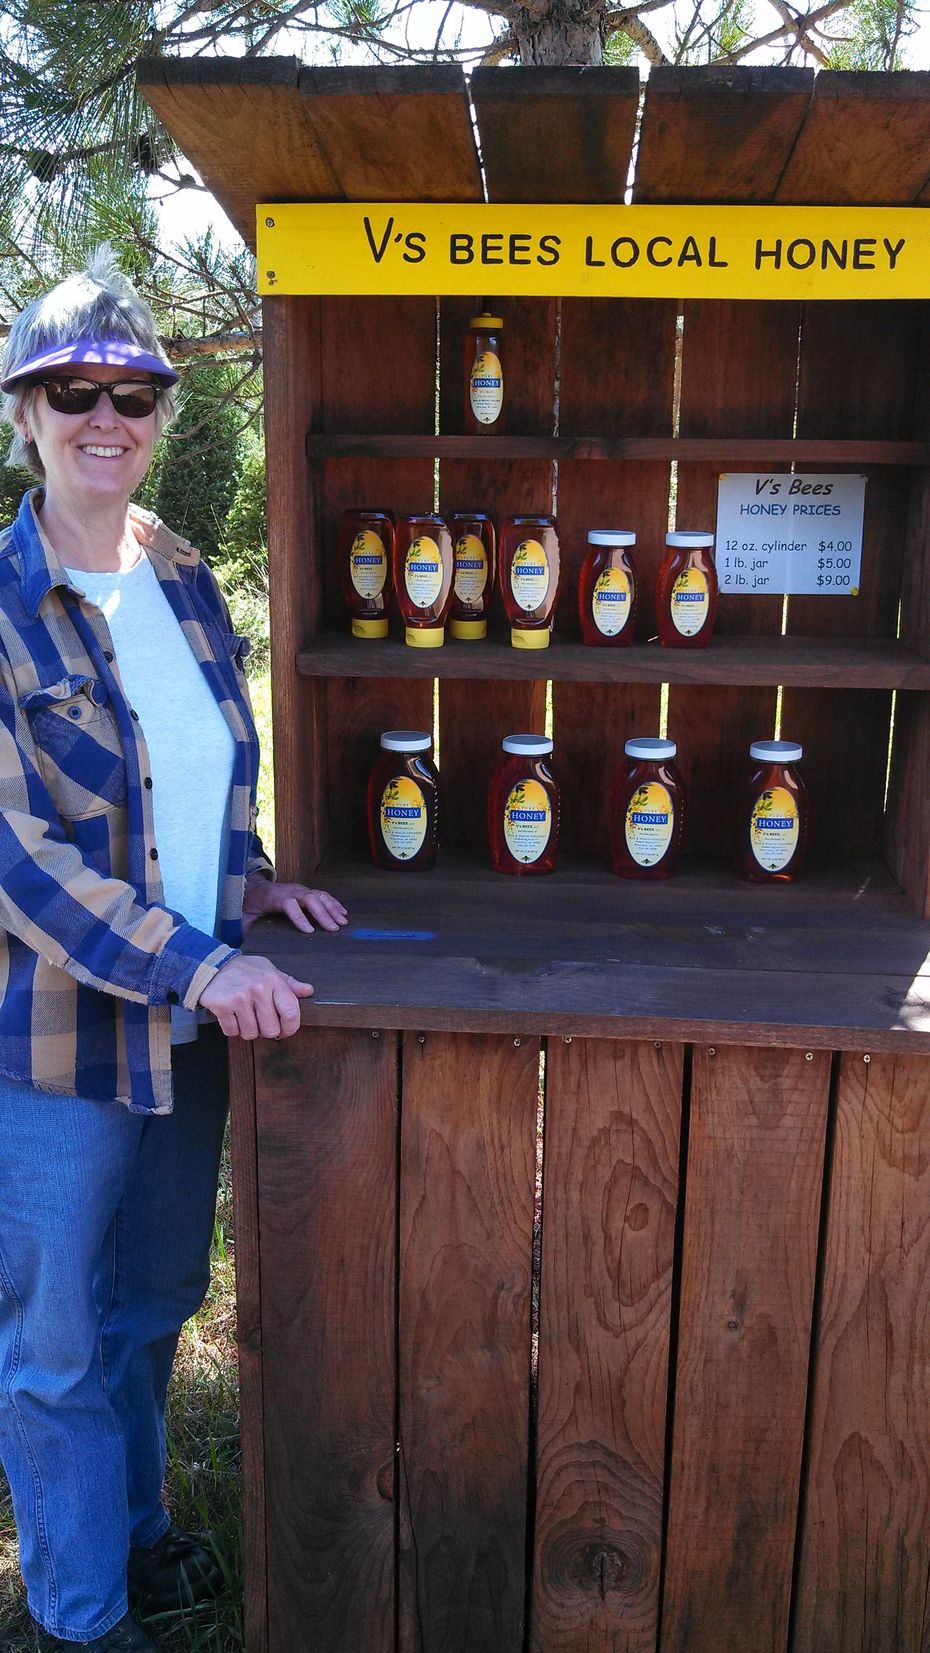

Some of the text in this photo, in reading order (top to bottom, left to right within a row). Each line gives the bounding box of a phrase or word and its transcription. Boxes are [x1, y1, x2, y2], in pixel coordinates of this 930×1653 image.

[363, 216, 906, 271] V's BEES LOCAL HONEY
[474, 379, 500, 387] HONEY
[755, 478, 834, 496] V's Bees
[739, 503, 841, 516] HONEY PRICES
[725, 540, 852, 554] 12 oz. cylinder $4.00
[355, 556, 381, 564] HONEY
[724, 557, 851, 571] 1 lb. jar $5.00
[410, 564, 438, 572] HONEY
[516, 567, 544, 575] HONEY
[724, 574, 850, 588] 2 lb. jar $9.00
[677, 593, 704, 601] HONEY
[387, 808, 420, 817] HONEY
[511, 812, 545, 820] HONEY
[633, 814, 667, 823] HONEY
[759, 819, 792, 828] HONEY
